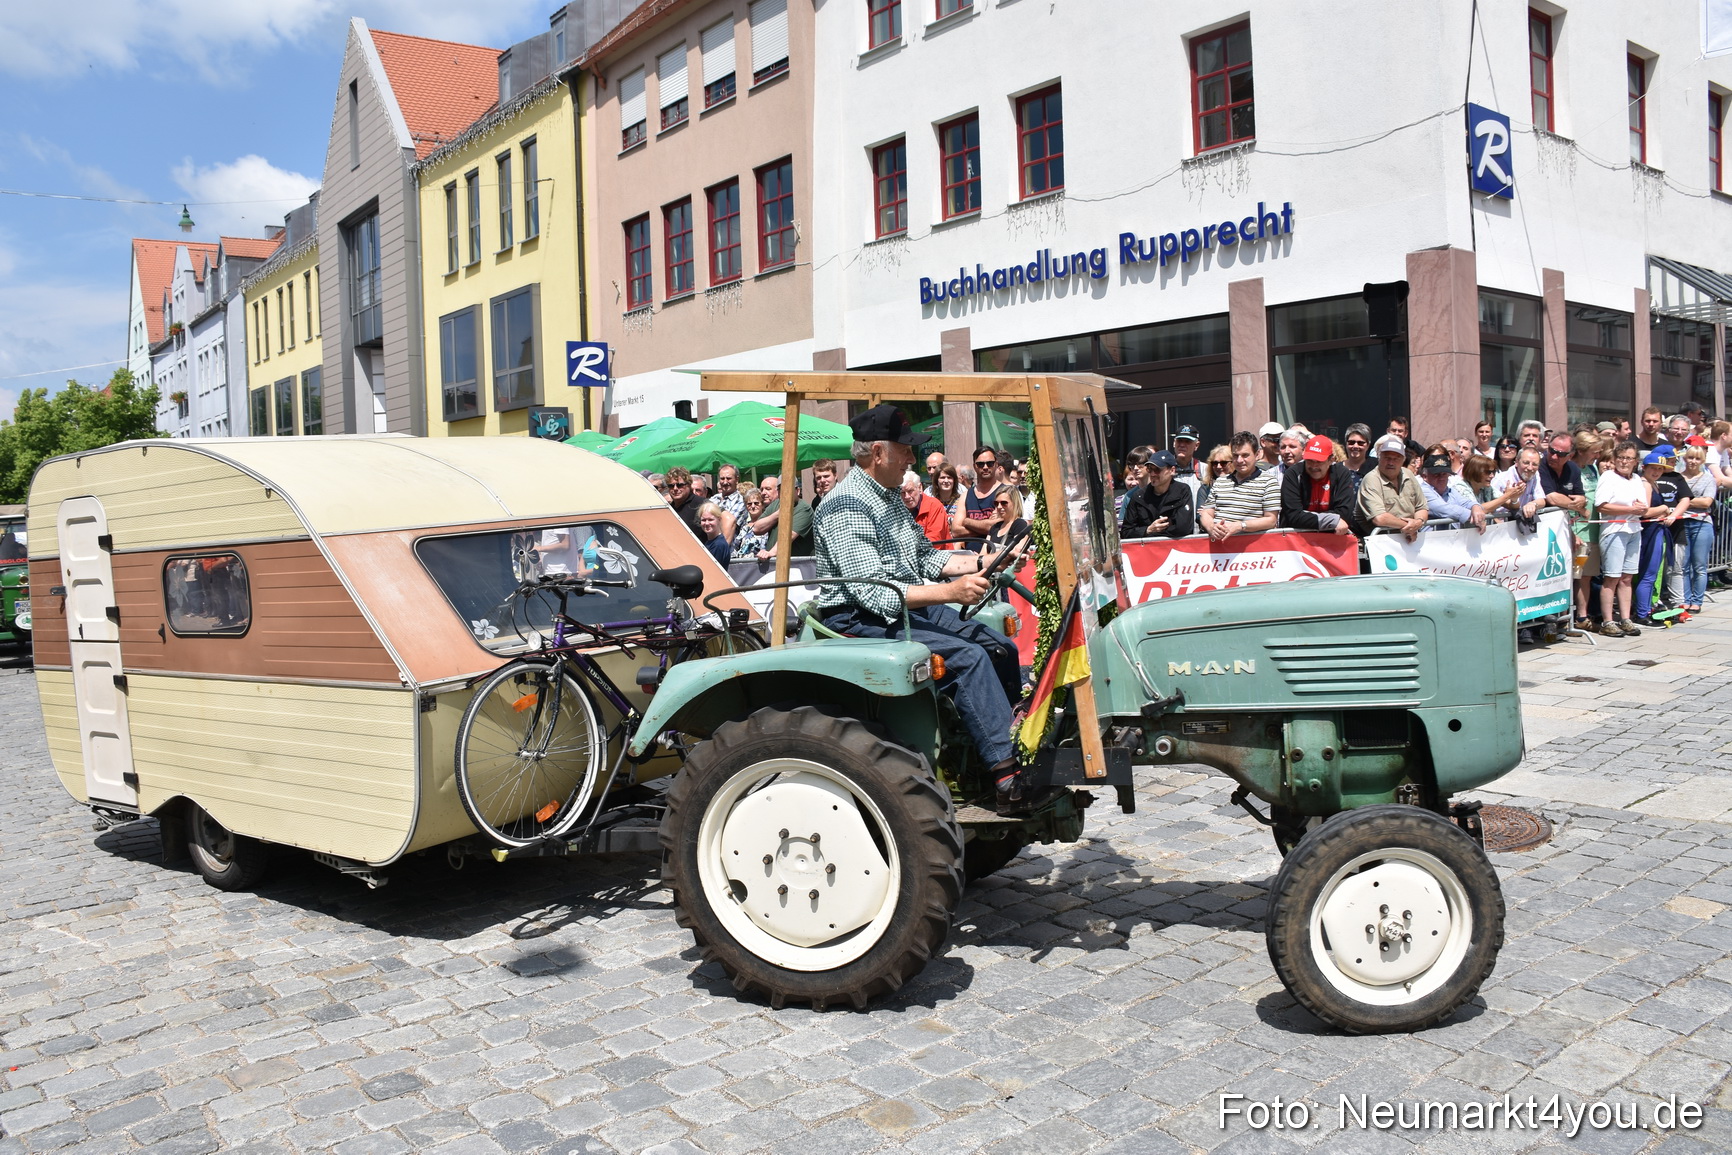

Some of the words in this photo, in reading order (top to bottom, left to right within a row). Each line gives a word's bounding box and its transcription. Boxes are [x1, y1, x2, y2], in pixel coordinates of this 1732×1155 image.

[920, 248, 1108, 304] Buchhandlung
[1119, 201, 1294, 267] Rupprecht
[628, 396, 639, 405] Markt
[639, 394, 645, 403] 15
[1166, 556, 1277, 576] Autoklassik
